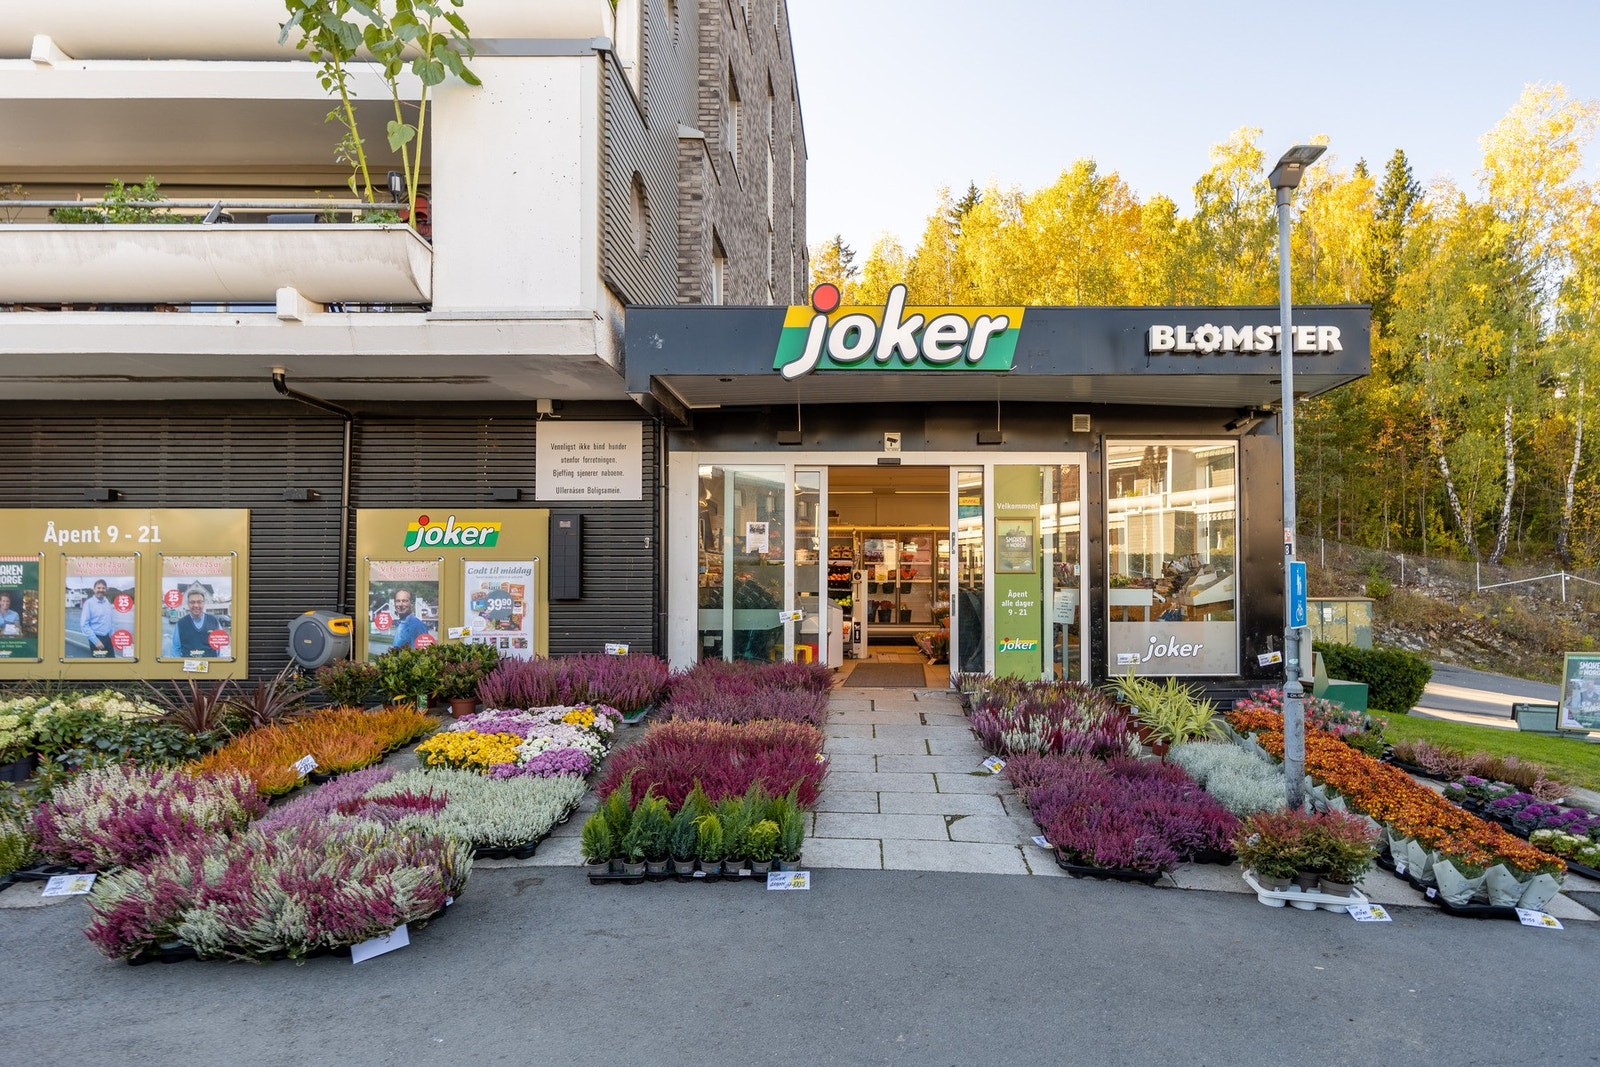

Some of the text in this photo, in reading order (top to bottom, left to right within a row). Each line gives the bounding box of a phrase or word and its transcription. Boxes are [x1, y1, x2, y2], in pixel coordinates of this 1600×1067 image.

[780, 283, 1010, 381] joker
[550, 443, 576, 452] Vennligst
[560, 456, 618, 465] utenfor forretningen.
[552, 469, 574, 478] Bjeffing
[577, 469, 598, 478] sjenerer
[555, 487, 621, 495] Ullernåsen Boligsameie.
[44, 520, 101, 547] Åpent
[106, 525, 119, 543] 9
[138, 525, 162, 543] 21
[406, 514, 495, 552] joker
[468, 567, 532, 576] Godt til middag
[0, 575, 23, 585] ORGE
[1007, 589, 1028, 599] Åpent
[1015, 600, 1034, 608] dager
[1000, 637, 1035, 653] joker
[1142, 635, 1204, 663] joker
